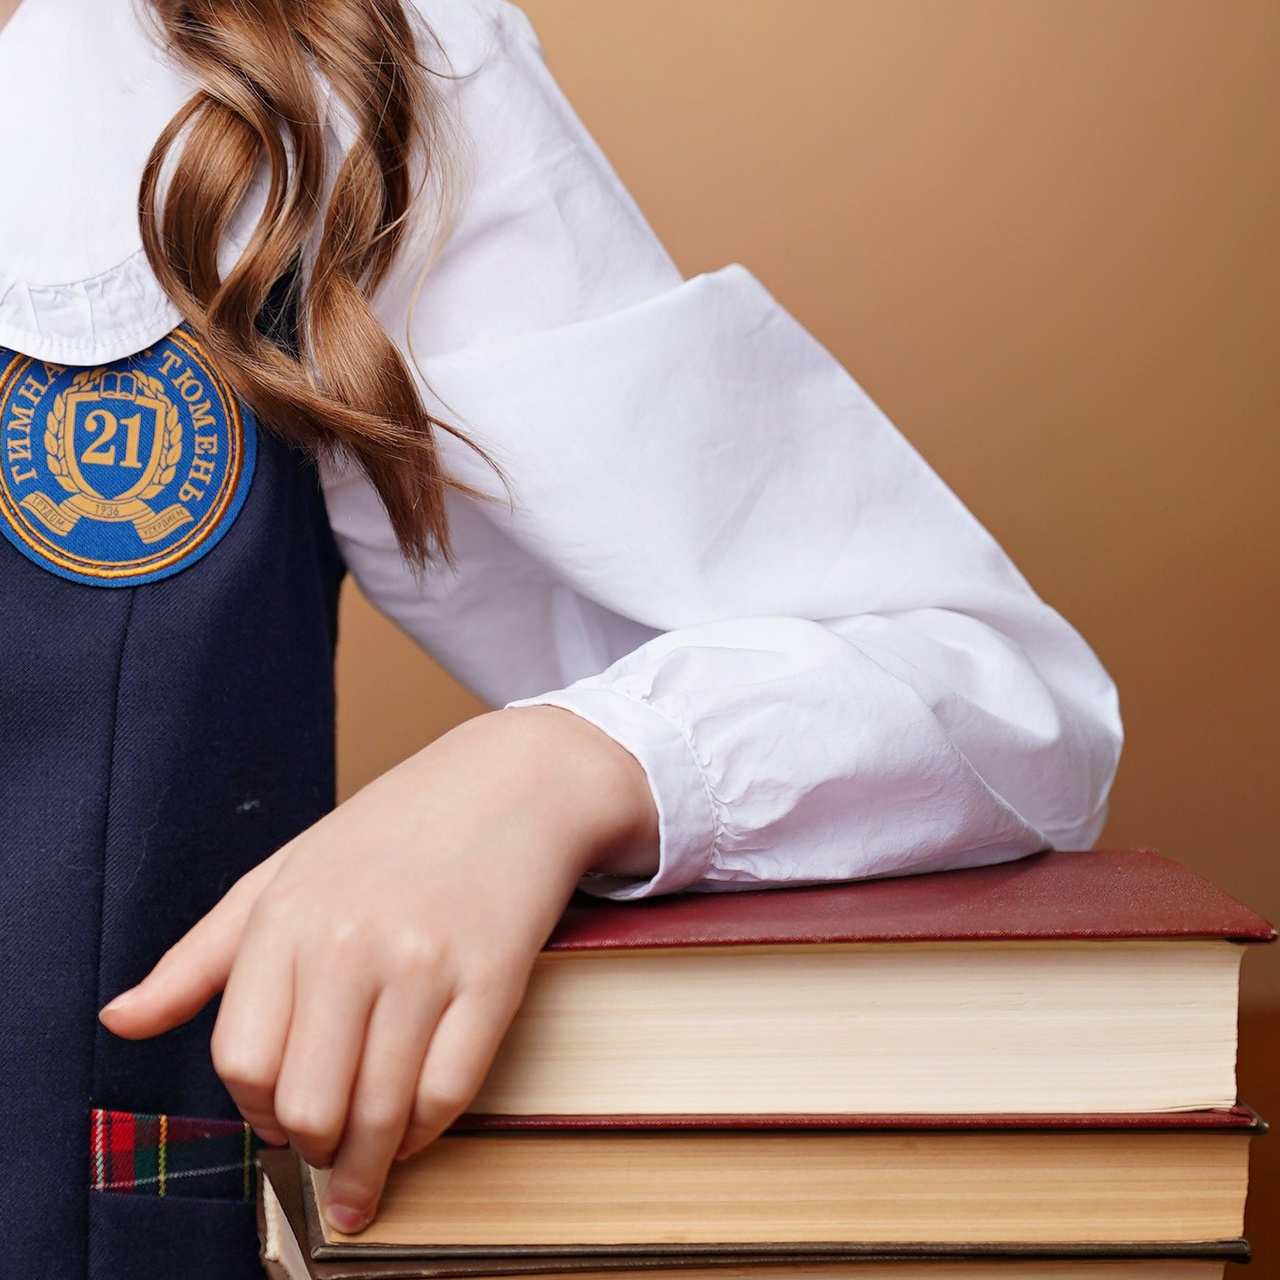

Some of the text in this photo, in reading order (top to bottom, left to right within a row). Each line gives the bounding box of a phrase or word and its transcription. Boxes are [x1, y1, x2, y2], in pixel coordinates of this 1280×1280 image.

[7, 350, 219, 502] ГИМНА ТЮМЕНЬ
[80, 408, 143, 469] 21
[32, 495, 65, 528] ТРУДОМ
[95, 503, 119, 517] 1936
